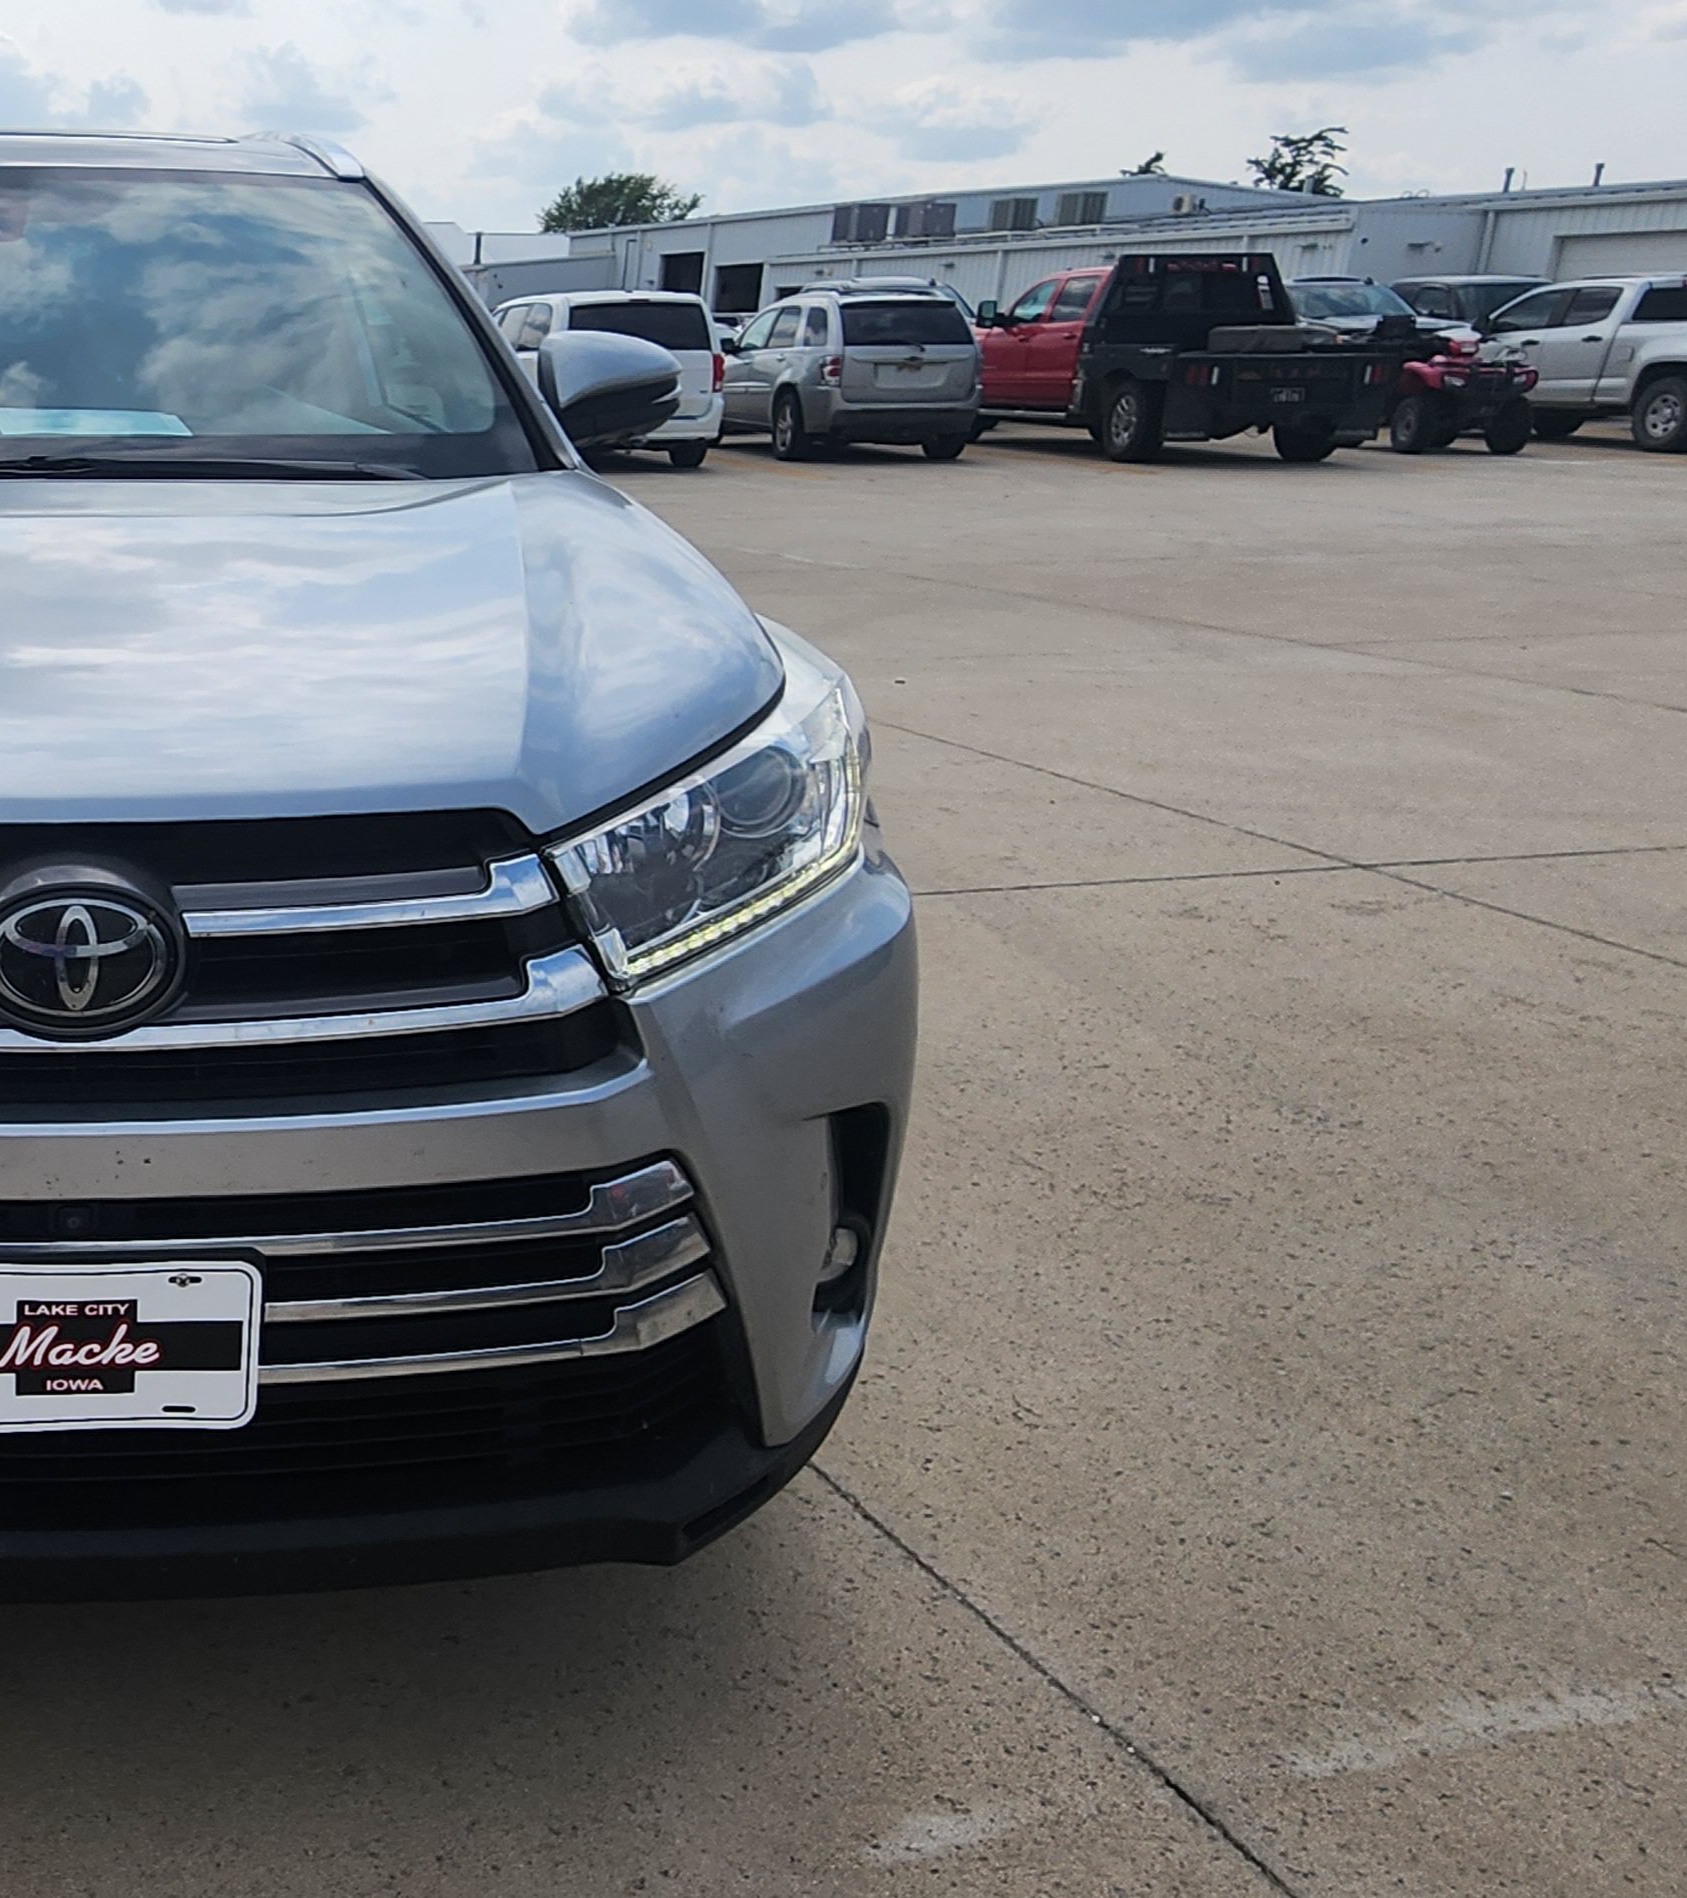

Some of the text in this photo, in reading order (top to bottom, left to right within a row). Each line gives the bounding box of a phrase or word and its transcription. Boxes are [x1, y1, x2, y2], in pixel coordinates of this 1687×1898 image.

[24, 1303, 129, 1316] LAKE CITY
[45, 1379, 104, 1391] IOWA
